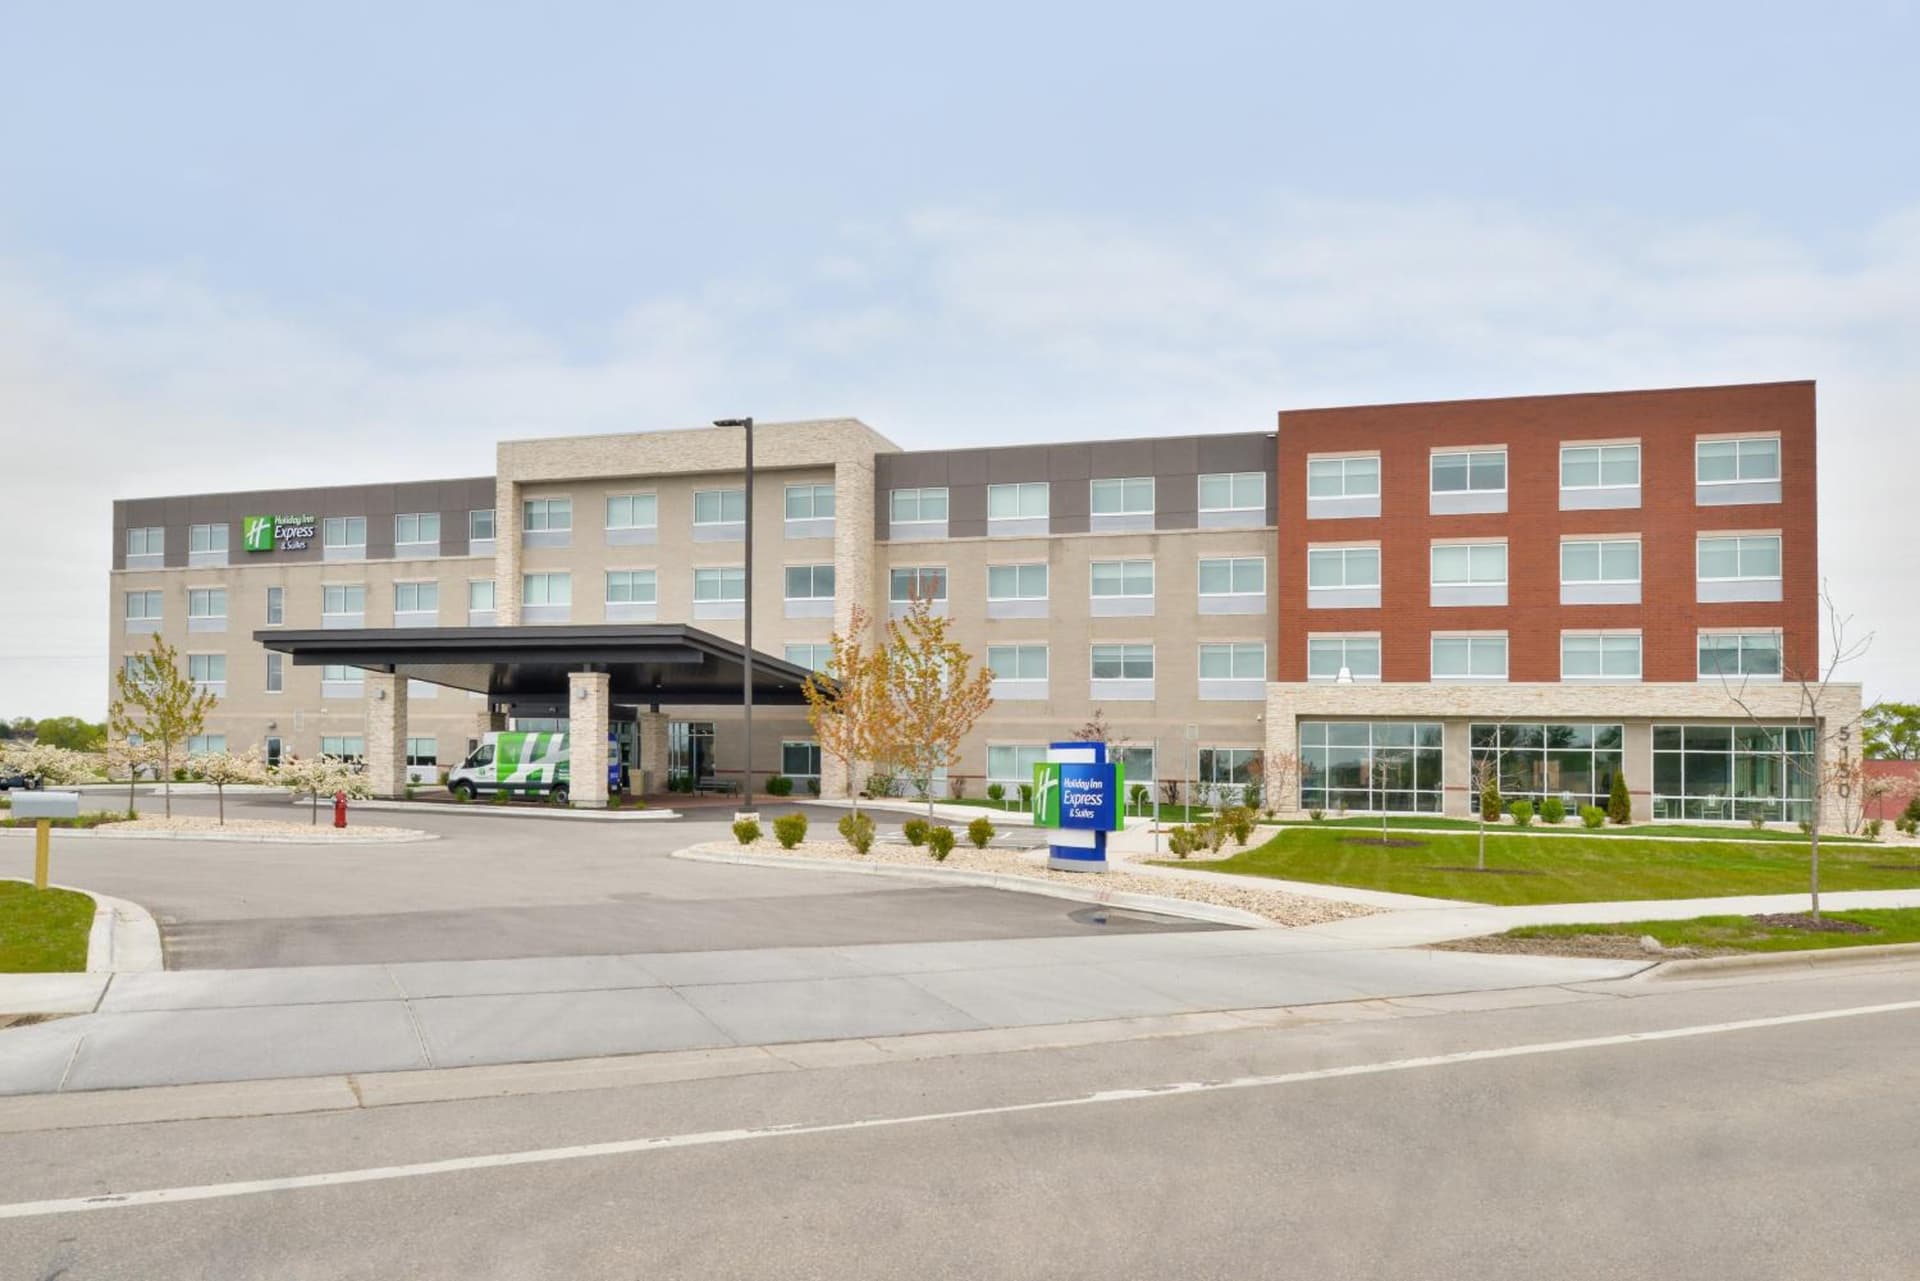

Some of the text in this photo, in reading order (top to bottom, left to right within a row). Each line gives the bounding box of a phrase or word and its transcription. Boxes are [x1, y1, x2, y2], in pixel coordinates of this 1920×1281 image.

[274, 514, 314, 526] Holiday Inn
[274, 525, 314, 541] Express
[287, 541, 306, 550] Suites
[1063, 777, 1103, 790] Holiday Inn
[1063, 791, 1103, 807] Express
[1075, 808, 1095, 819] Suites
